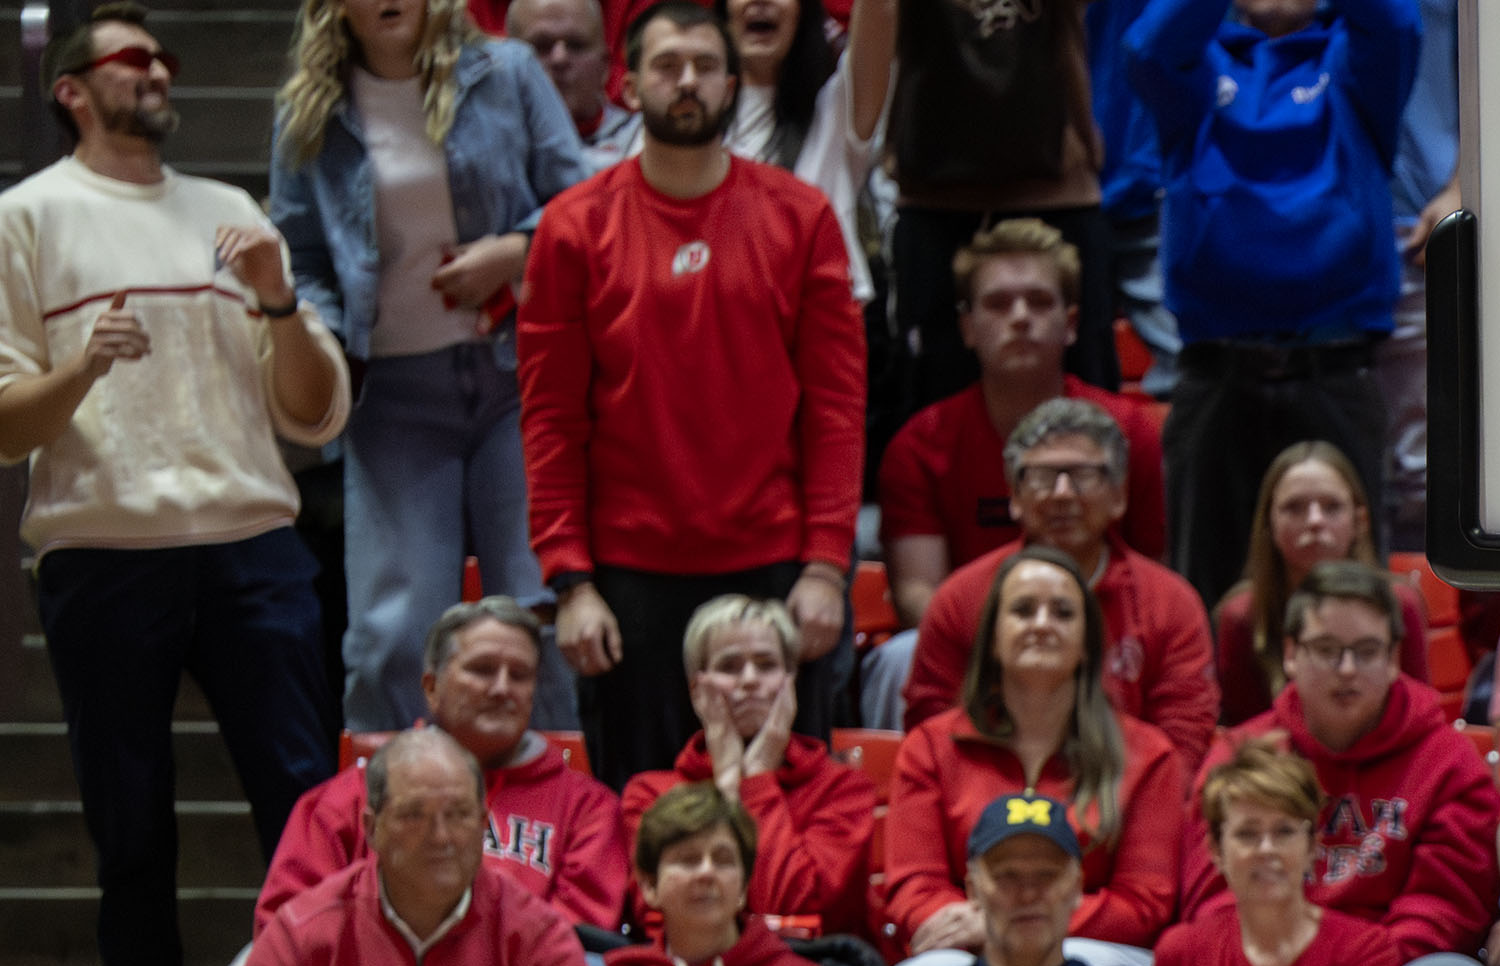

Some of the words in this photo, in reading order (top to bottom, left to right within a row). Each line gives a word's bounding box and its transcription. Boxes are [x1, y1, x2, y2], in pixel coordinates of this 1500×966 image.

[1006, 798, 1052, 827] M
[1322, 793, 1408, 841] AH
[483, 811, 555, 878] AH
